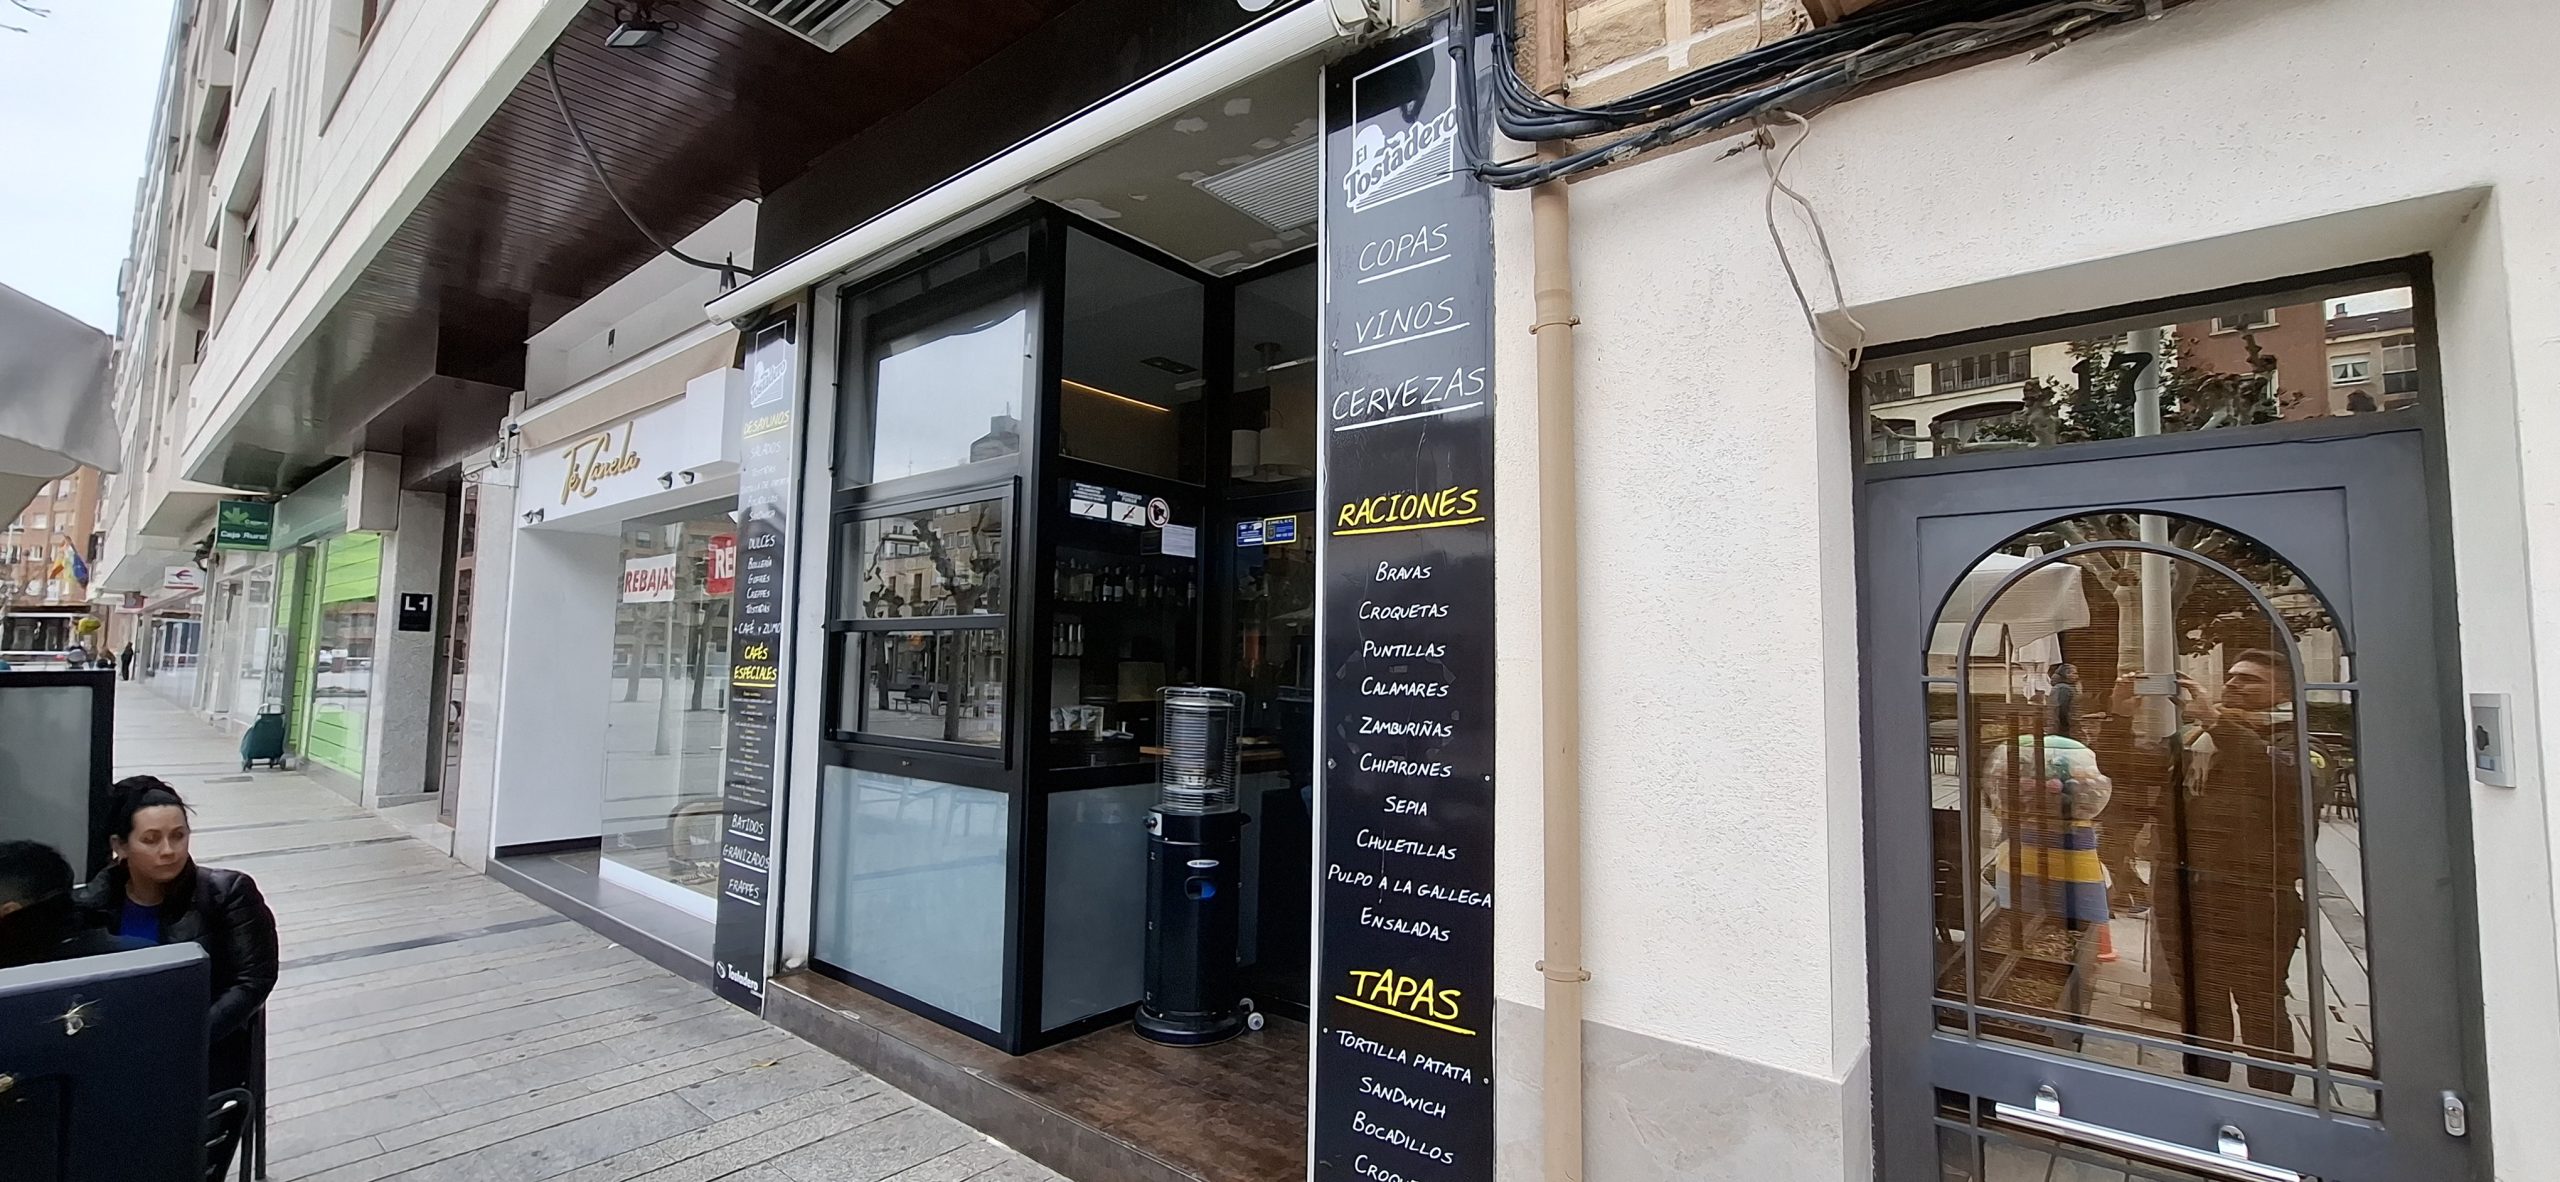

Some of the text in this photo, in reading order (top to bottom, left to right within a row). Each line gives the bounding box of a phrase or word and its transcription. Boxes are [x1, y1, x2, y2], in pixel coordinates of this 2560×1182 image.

[1345, 107, 1457, 205] Tostadero
[1356, 144, 1367, 167] El
[1358, 222, 1449, 273] COPAS
[1355, 297, 1455, 345] VINOS
[2071, 351, 2153, 408] 17
[1332, 367, 1487, 421] CERVEZAS
[744, 410, 790, 435] DESAYUNOS
[1337, 486, 1479, 527] RACIONES
[243, 531, 268, 540] Rural
[748, 534, 776, 550] DULCES
[625, 567, 676, 597] REBAJAS
[1375, 561, 1432, 582] BRAVAS
[1358, 600, 1449, 621] CROQUETAS
[744, 641, 768, 660] CAFÉS
[1363, 641, 1447, 659] PUNTILLAS
[734, 665, 778, 681] ESPECIALES
[1360, 676, 1449, 698] CALAMARES
[1359, 716, 1453, 738] ZAMBURIÑAS
[1359, 753, 1452, 778] CHIPIRONES
[1384, 797, 1428, 817] SEPIA
[732, 813, 765, 835] BATIDOS
[722, 844, 770, 870] GRANIZADOS
[1356, 829, 1457, 861] CHULETILLAS
[728, 878, 761, 899] FRAPPES
[1327, 864, 1492, 908] PULPO A LA GALLEGA
[1360, 907, 1450, 942] ENSALADAS
[728, 963, 759, 991] Tostadero
[1349, 968, 1462, 1021] TAPAS
[1336, 1029, 1472, 1084] TORTILLA PATATA
[1359, 1076, 1446, 1118] SANDWICH
[1352, 1110, 1454, 1165] BOCADILLOS
[1355, 1155, 1419, 1182] CROQ
